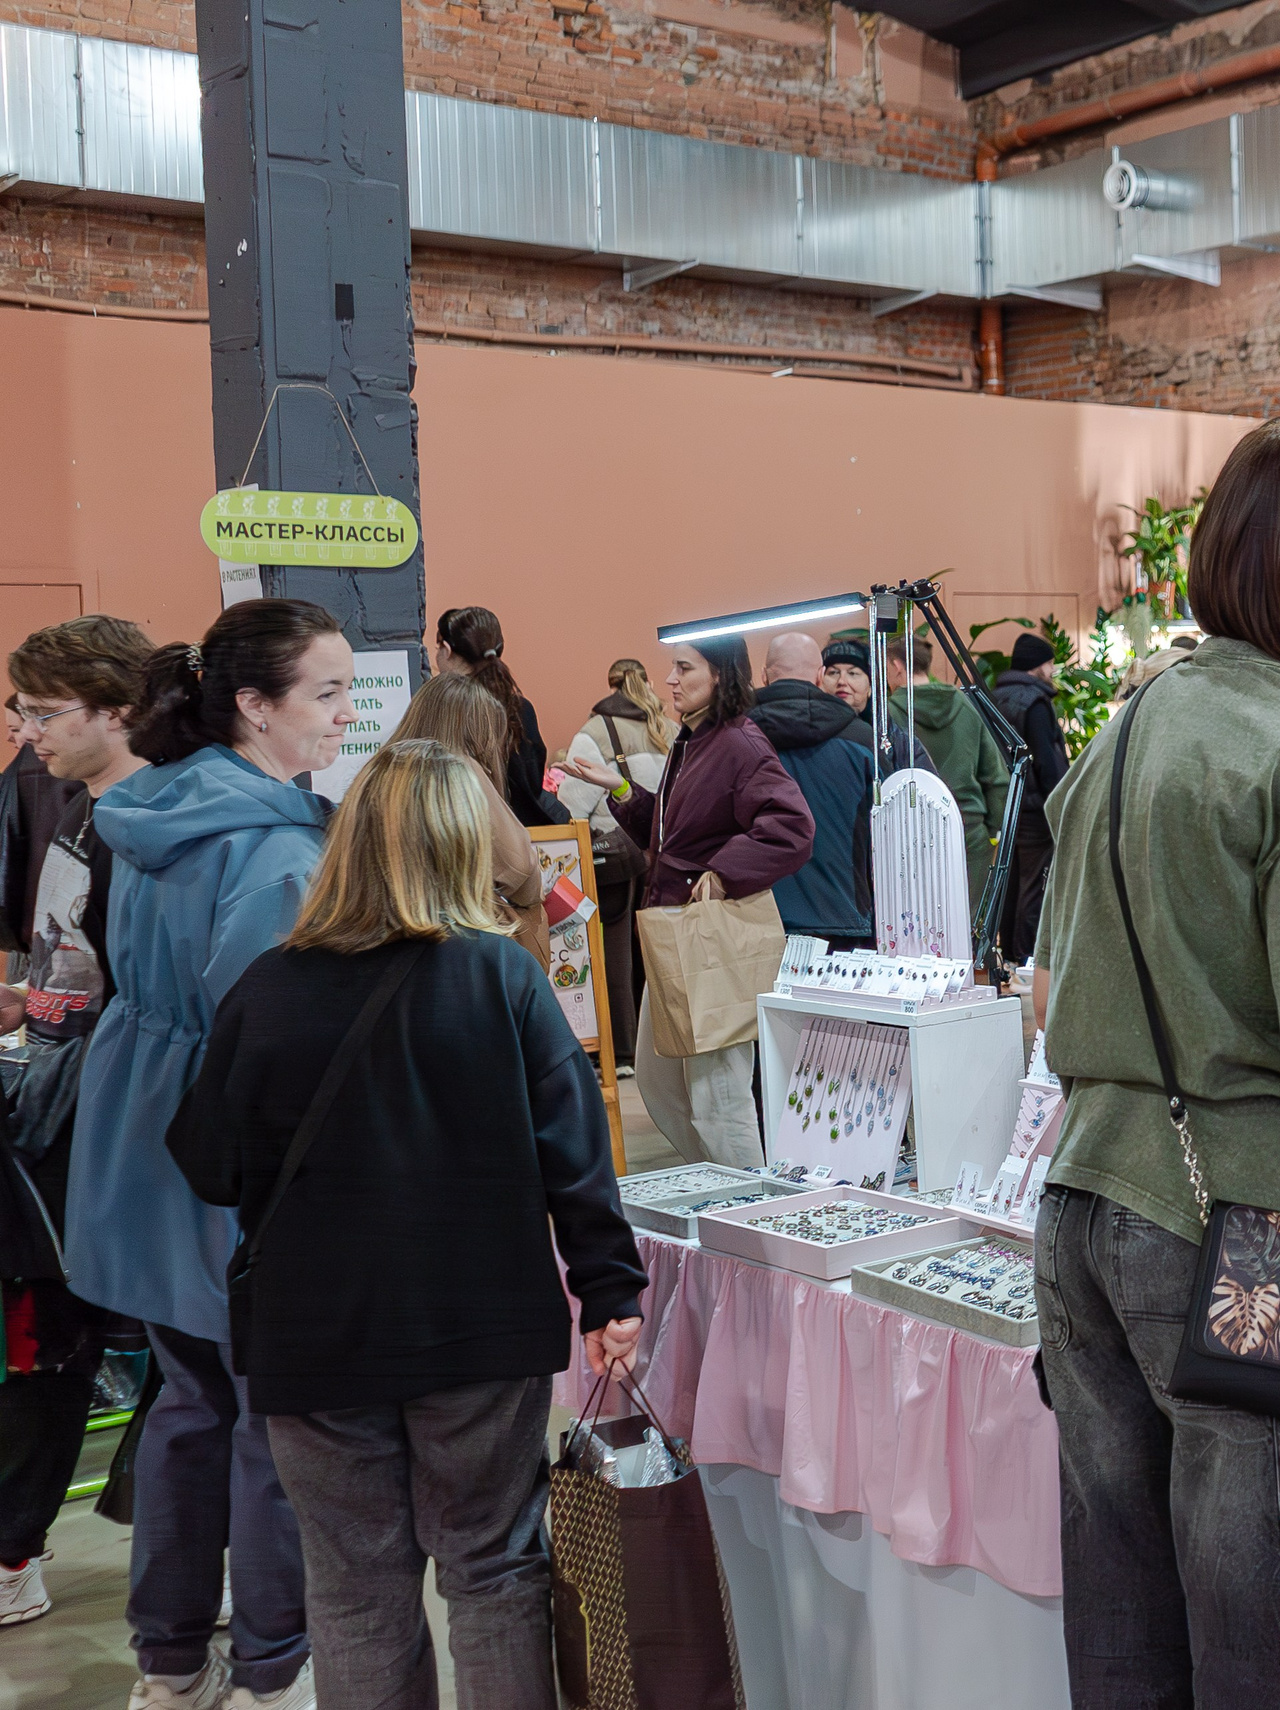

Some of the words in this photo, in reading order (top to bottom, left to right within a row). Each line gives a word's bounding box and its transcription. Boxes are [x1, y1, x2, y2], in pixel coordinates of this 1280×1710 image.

[216, 521, 404, 543] МАСТЕР-КЛАССЫ
[350, 676, 403, 690] МОЖНО
[353, 698, 383, 710] ТАТЬ
